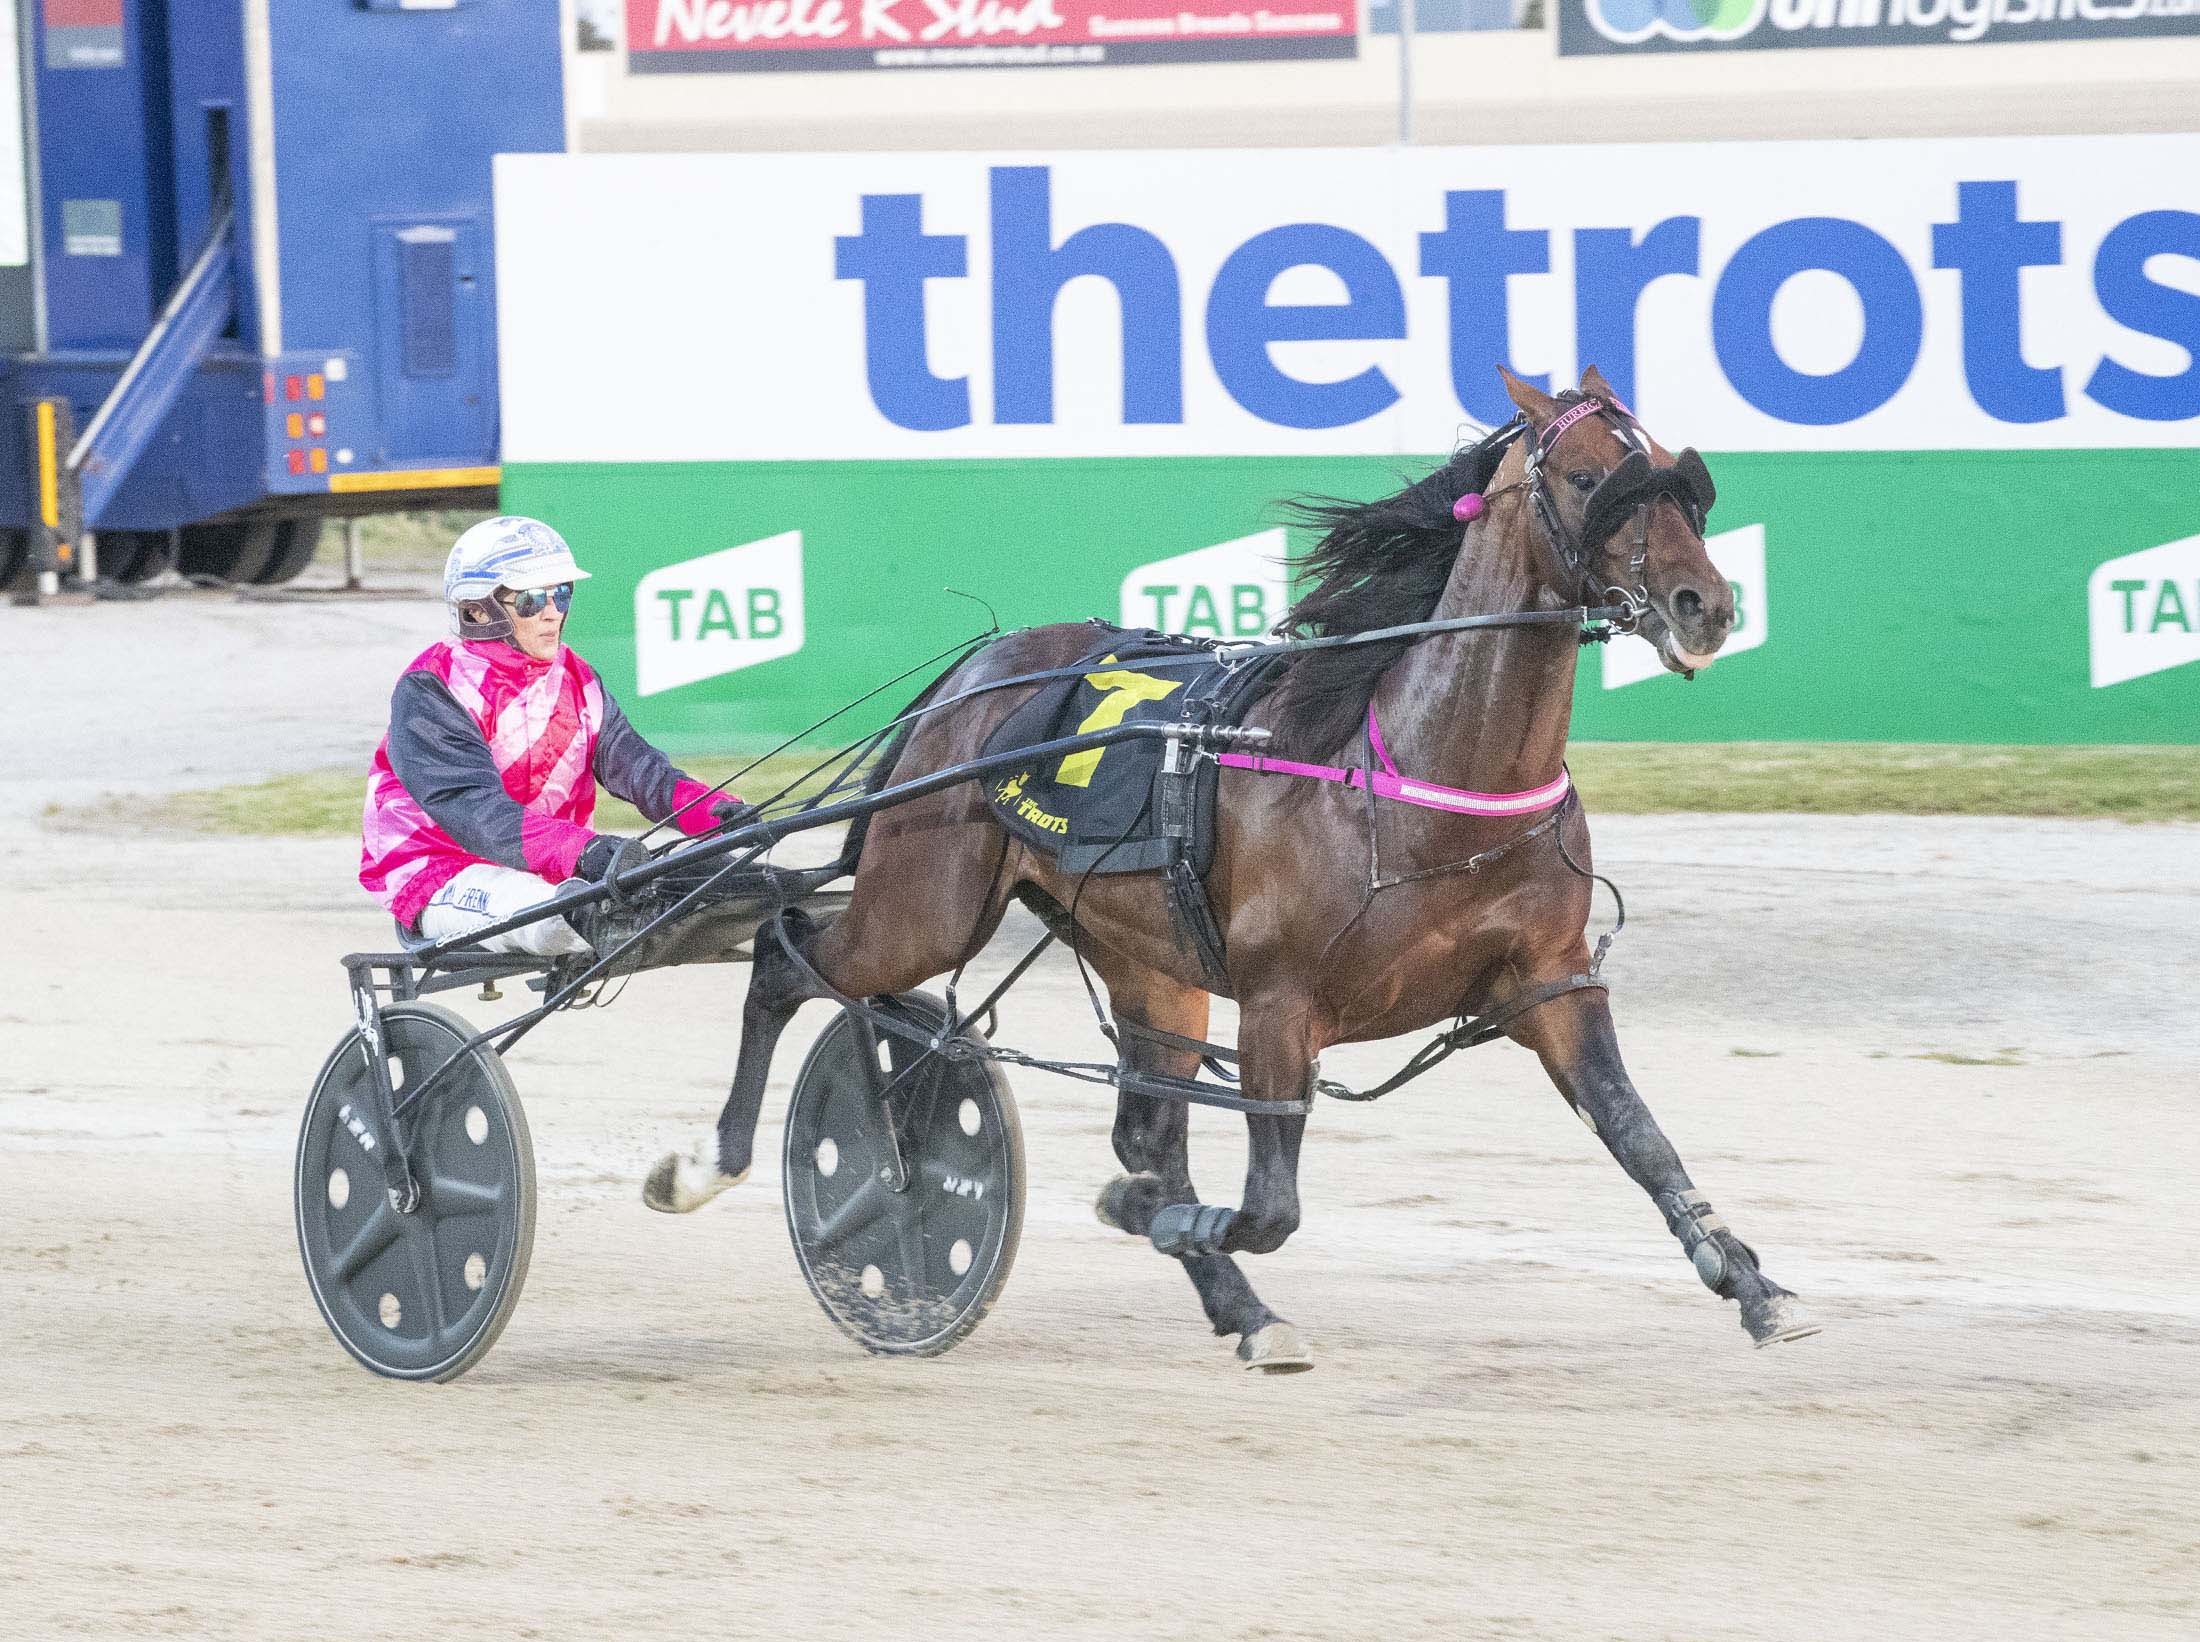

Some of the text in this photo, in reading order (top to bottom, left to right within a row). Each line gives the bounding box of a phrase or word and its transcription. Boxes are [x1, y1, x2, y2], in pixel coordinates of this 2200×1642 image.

[653, 0, 849, 47] Nevele
[861, 0, 912, 41] K
[834, 165, 2200, 432] thetrots
[655, 587, 784, 641] TAB
[1141, 583, 1269, 637] TAB
[2110, 579, 2200, 634] TA
[1055, 654, 1183, 788] 7
[1017, 800, 1068, 835] TROTS
